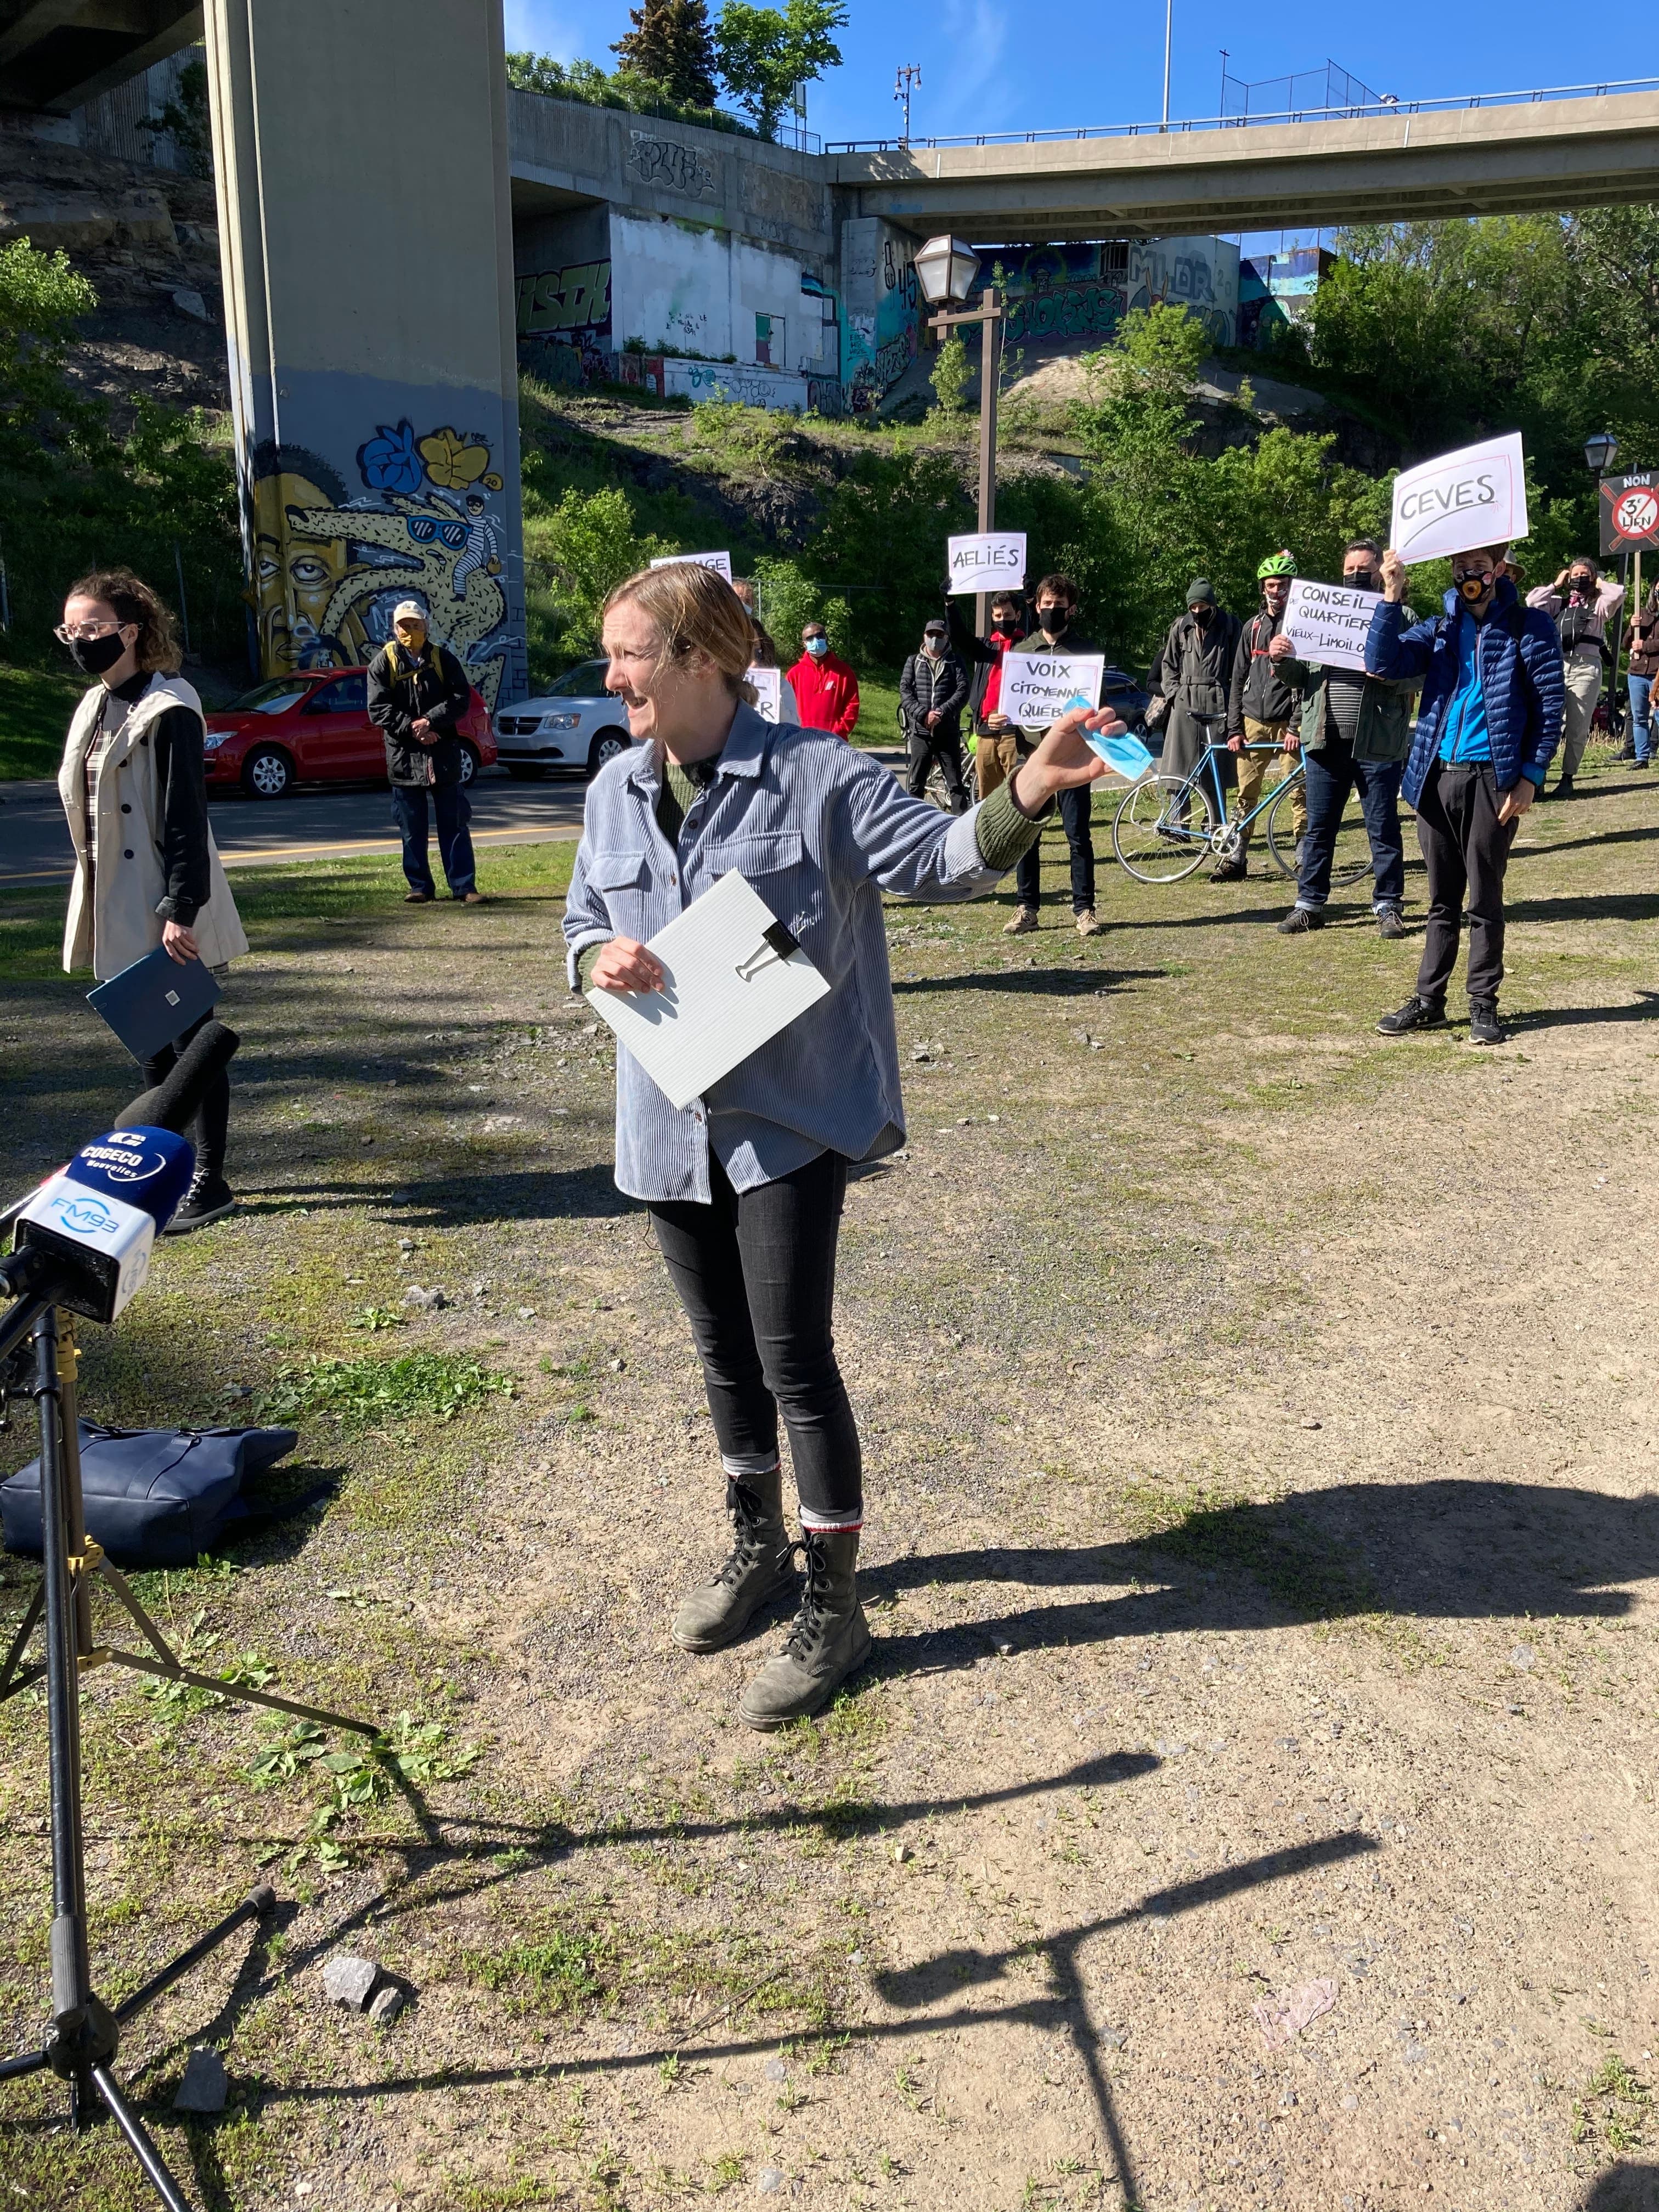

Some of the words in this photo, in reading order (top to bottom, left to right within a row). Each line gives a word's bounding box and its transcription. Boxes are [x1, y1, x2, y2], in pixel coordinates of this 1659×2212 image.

[486, 478, 498, 487] 20
[1623, 473, 1651, 488] NON
[1400, 474, 1495, 520] CEVES
[1623, 515, 1651, 527] LIEN
[1018, 702, 1063, 718] QUÉB
[80, 1146, 144, 1167] COGECO
[86, 1159, 138, 1179] Nouvelles
[50, 1198, 120, 1233] FM93
